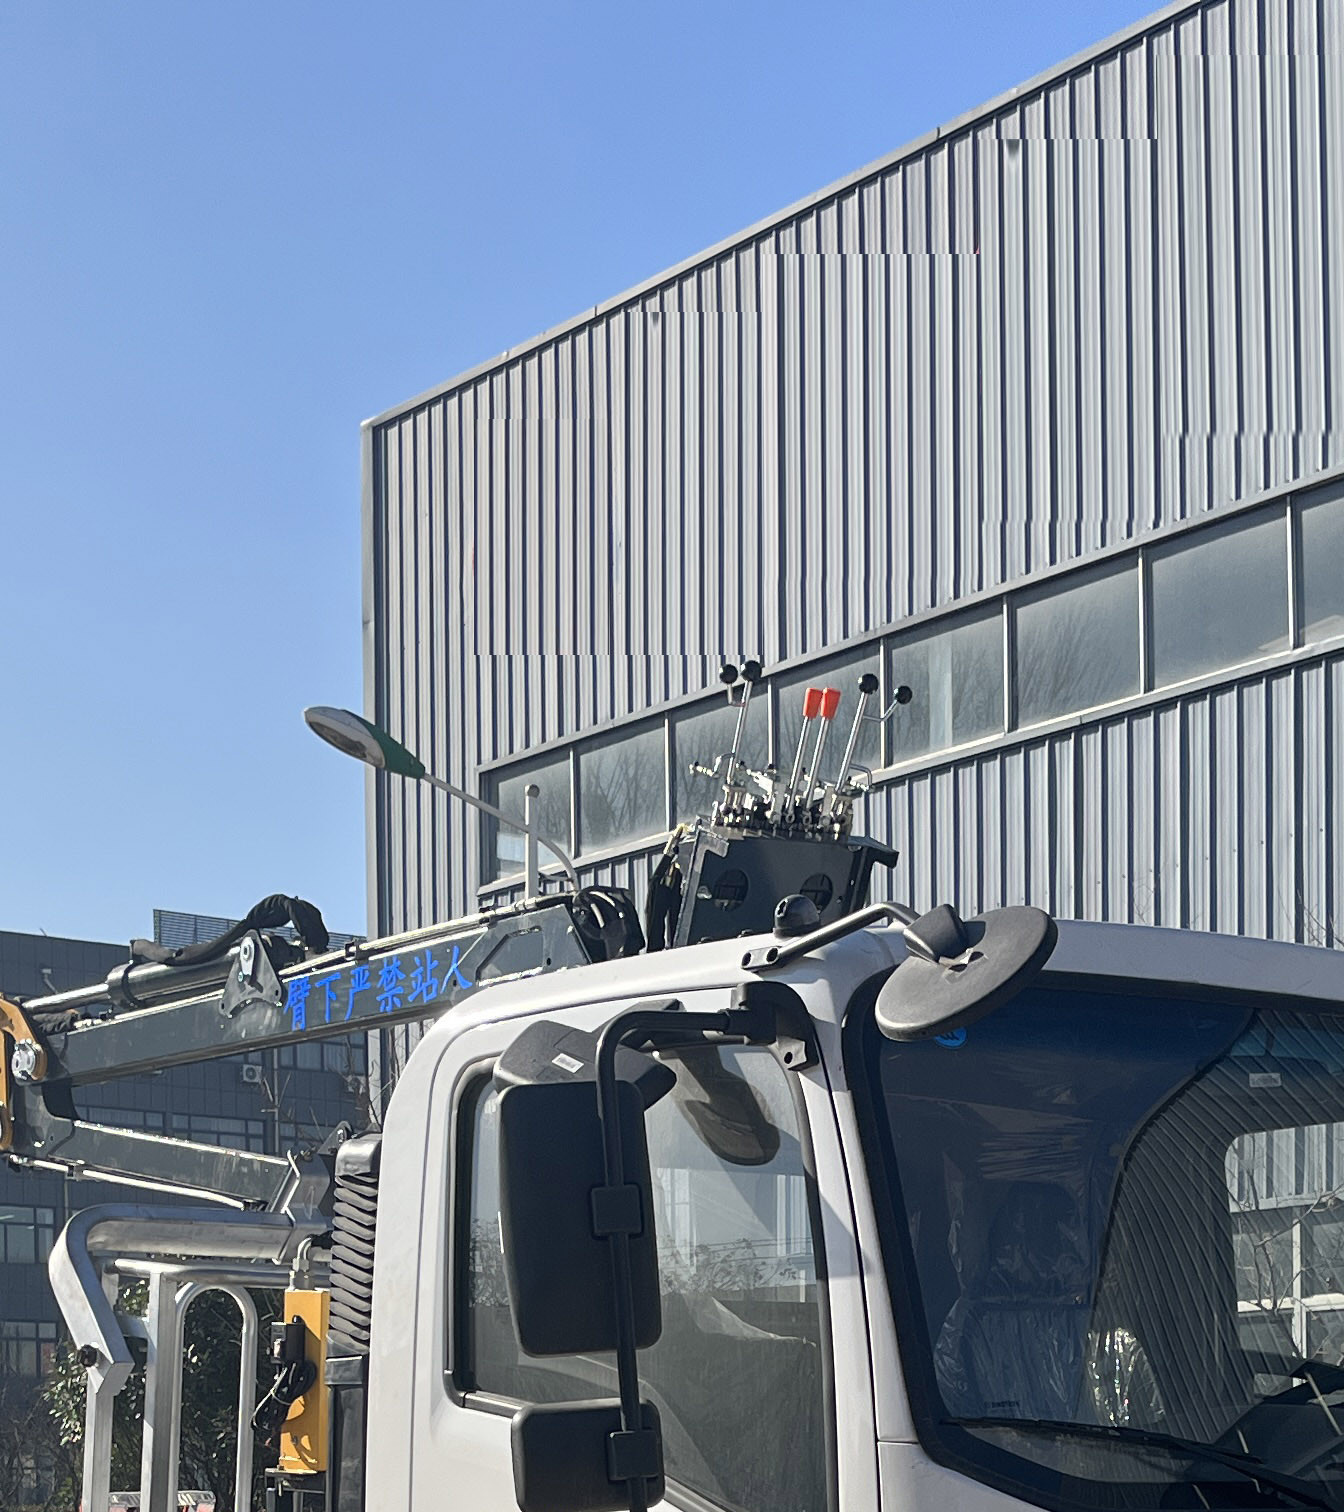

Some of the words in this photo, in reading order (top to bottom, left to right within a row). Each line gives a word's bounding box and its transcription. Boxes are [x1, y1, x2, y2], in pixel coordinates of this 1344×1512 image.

[283, 945, 473, 1032] 臂下严禁站人
